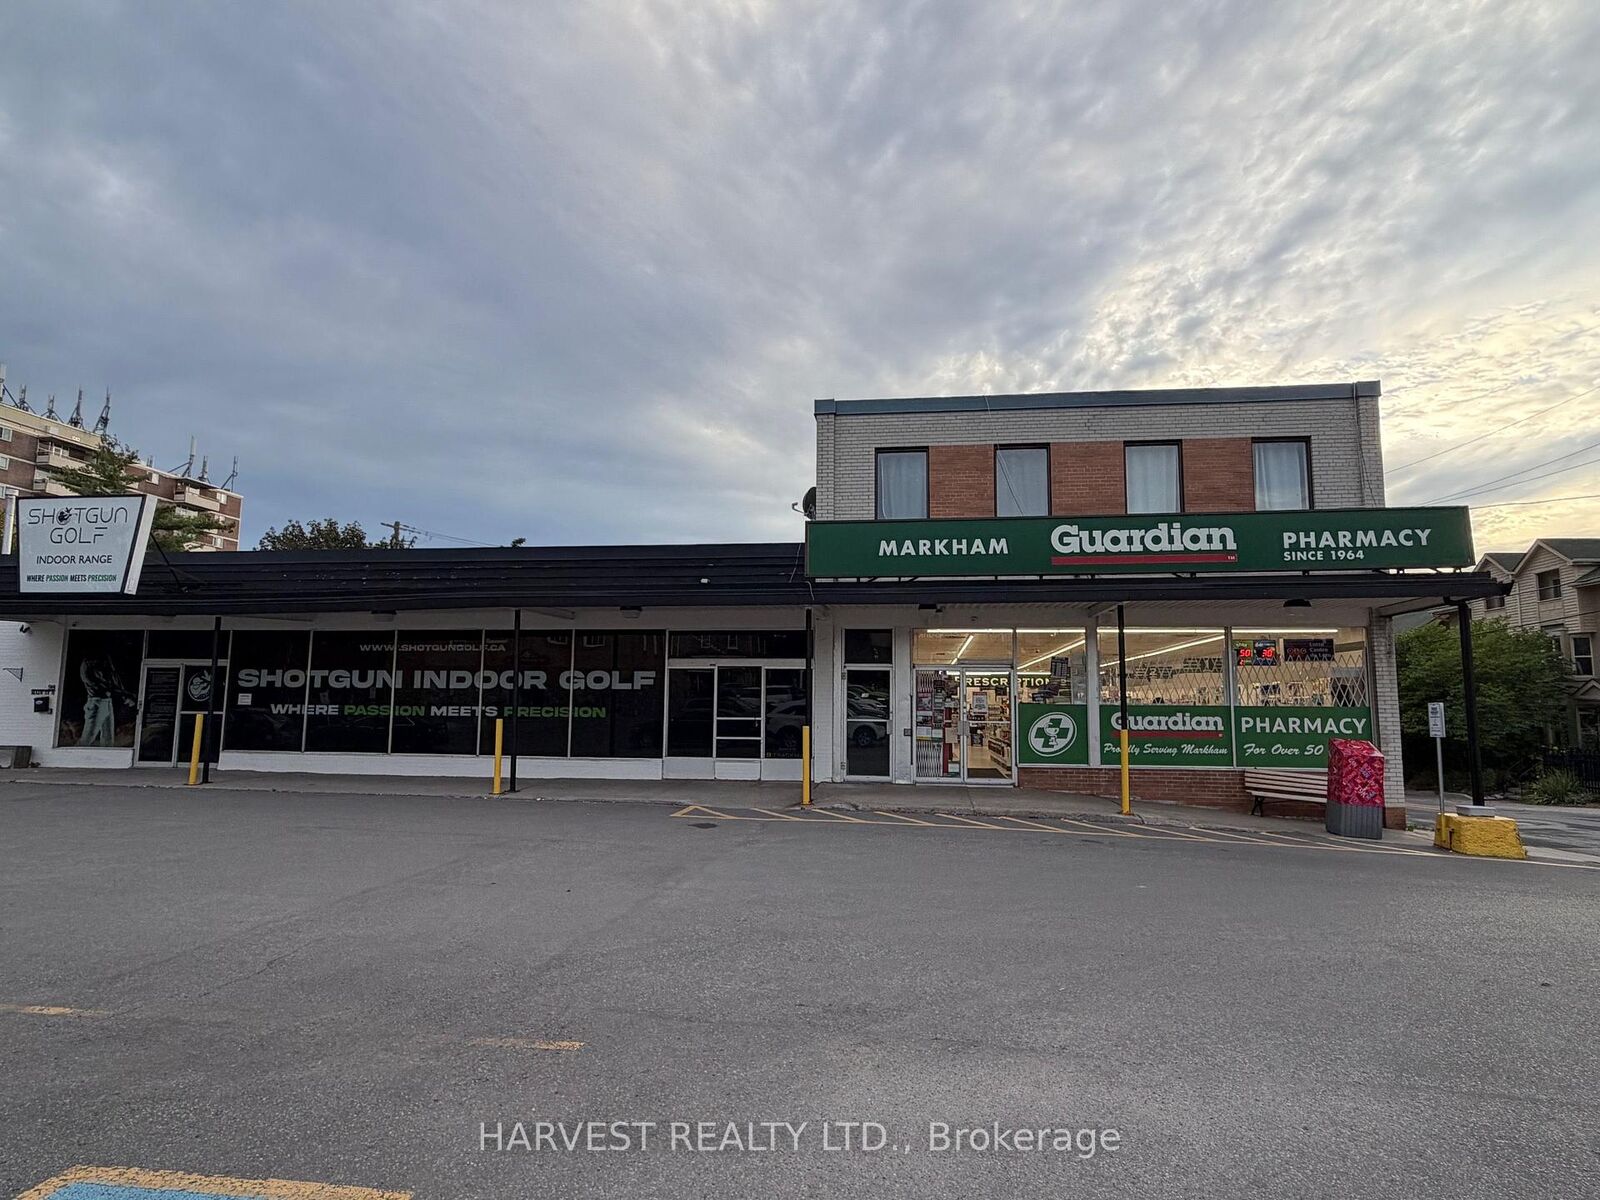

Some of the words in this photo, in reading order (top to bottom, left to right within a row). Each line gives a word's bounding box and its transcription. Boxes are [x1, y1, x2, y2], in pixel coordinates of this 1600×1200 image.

[28, 507, 128, 525] SHOTGUN
[50, 527, 108, 544] GOLF
[1050, 522, 1237, 554] Guardian
[1282, 528, 1432, 549] PHARMACY
[878, 537, 1009, 557] MARKHAM
[1283, 550, 1324, 561] SINCE
[1331, 549, 1365, 561] 1964
[36, 555, 76, 565] INDOOR
[78, 554, 113, 564] RANGE
[26, 574, 45, 582] WHERE
[45, 574, 69, 582] PASSION
[69, 574, 87, 582] MEETS
[87, 574, 117, 582] PRECISION
[237, 669, 403, 689] SHOTGUN
[413, 670, 546, 690] INDOOR
[558, 670, 656, 690] GOLF
[954, 676, 1051, 686] PRESCRTIO
[270, 703, 339, 716] WHERE
[344, 705, 425, 717] PASSION
[430, 705, 498, 718] MEETS
[503, 706, 606, 719] PRECISION
[1110, 712, 1224, 731] Guardian
[1241, 717, 1366, 734] PHARMACY
[1103, 742, 1140, 755] Prodly
[1143, 743, 1178, 757] Serving
[1181, 743, 1228, 755] Markham
[1243, 743, 1267, 756] For
[1271, 743, 1300, 756] Over
[1304, 744, 1324, 756] 50
